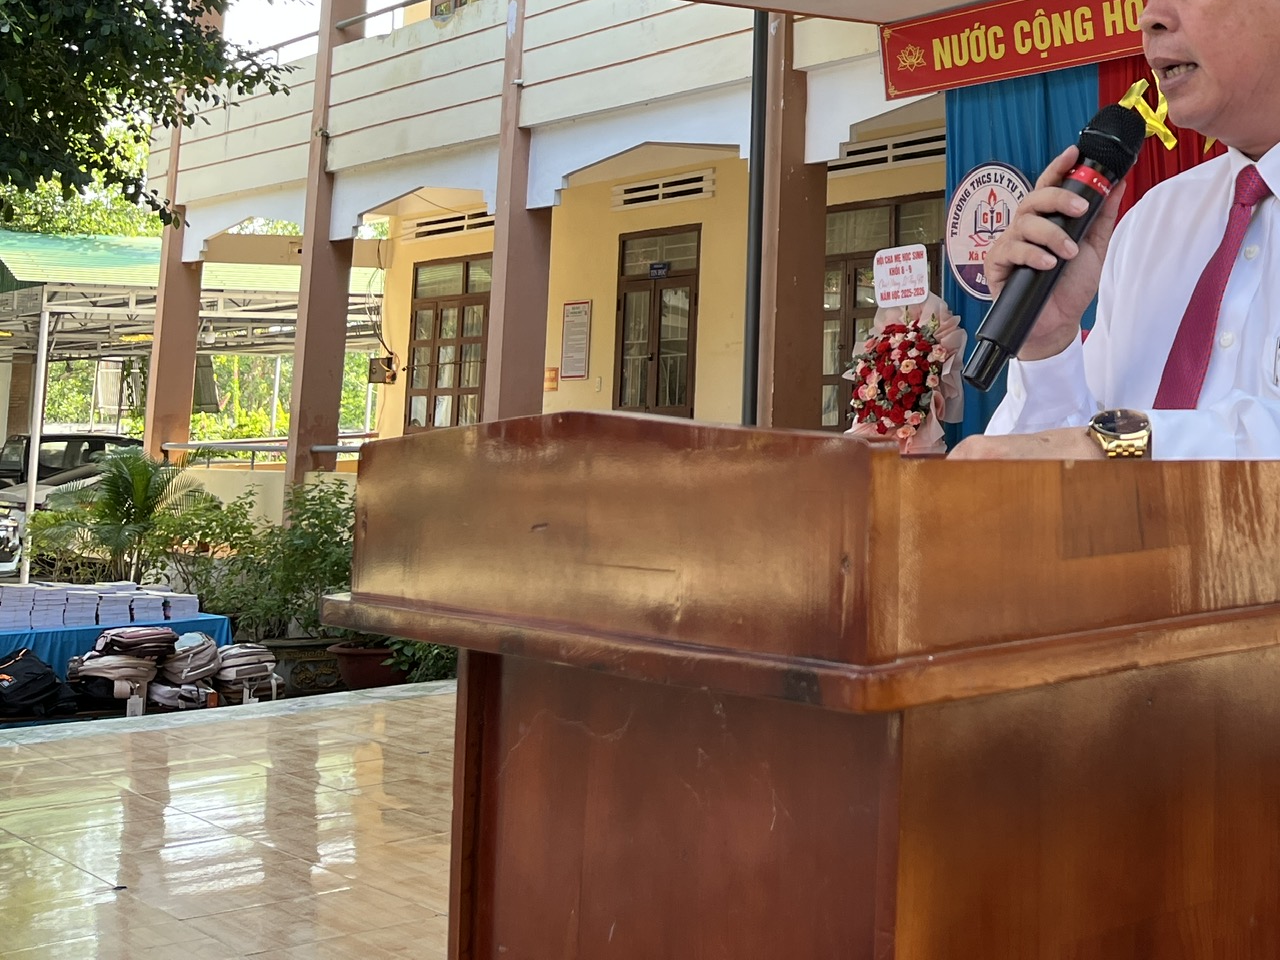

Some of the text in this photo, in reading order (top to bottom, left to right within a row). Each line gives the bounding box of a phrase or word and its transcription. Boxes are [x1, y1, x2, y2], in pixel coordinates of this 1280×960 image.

[932, 22, 1006, 71] NƯỚC
[1013, 8, 1095, 59] CỘNG
[969, 172, 992, 191] THCS
